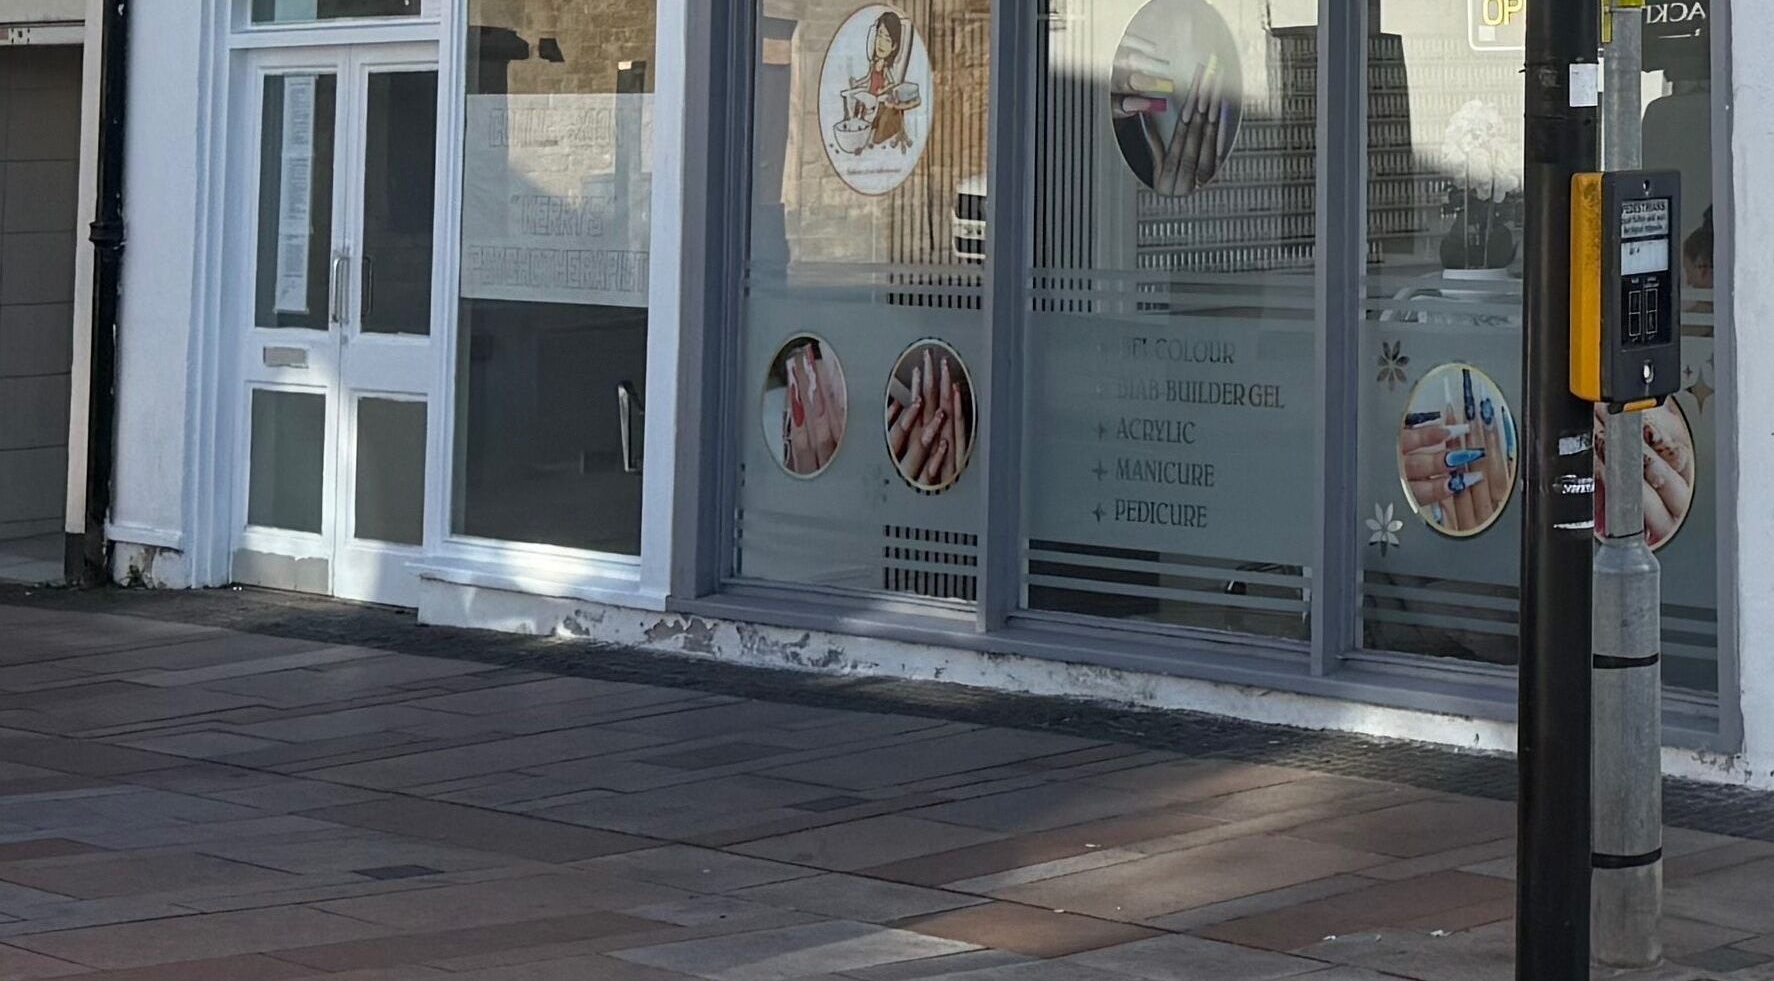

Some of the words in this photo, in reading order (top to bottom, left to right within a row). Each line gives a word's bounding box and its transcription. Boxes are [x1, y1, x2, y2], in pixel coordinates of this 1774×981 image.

[1154, 337, 1236, 364] COLOUR
[1248, 383, 1286, 409] GEL
[1116, 417, 1197, 444] ACRYLIC
[1115, 457, 1215, 488] MANICURE
[1114, 498, 1208, 528] PEDICURE
